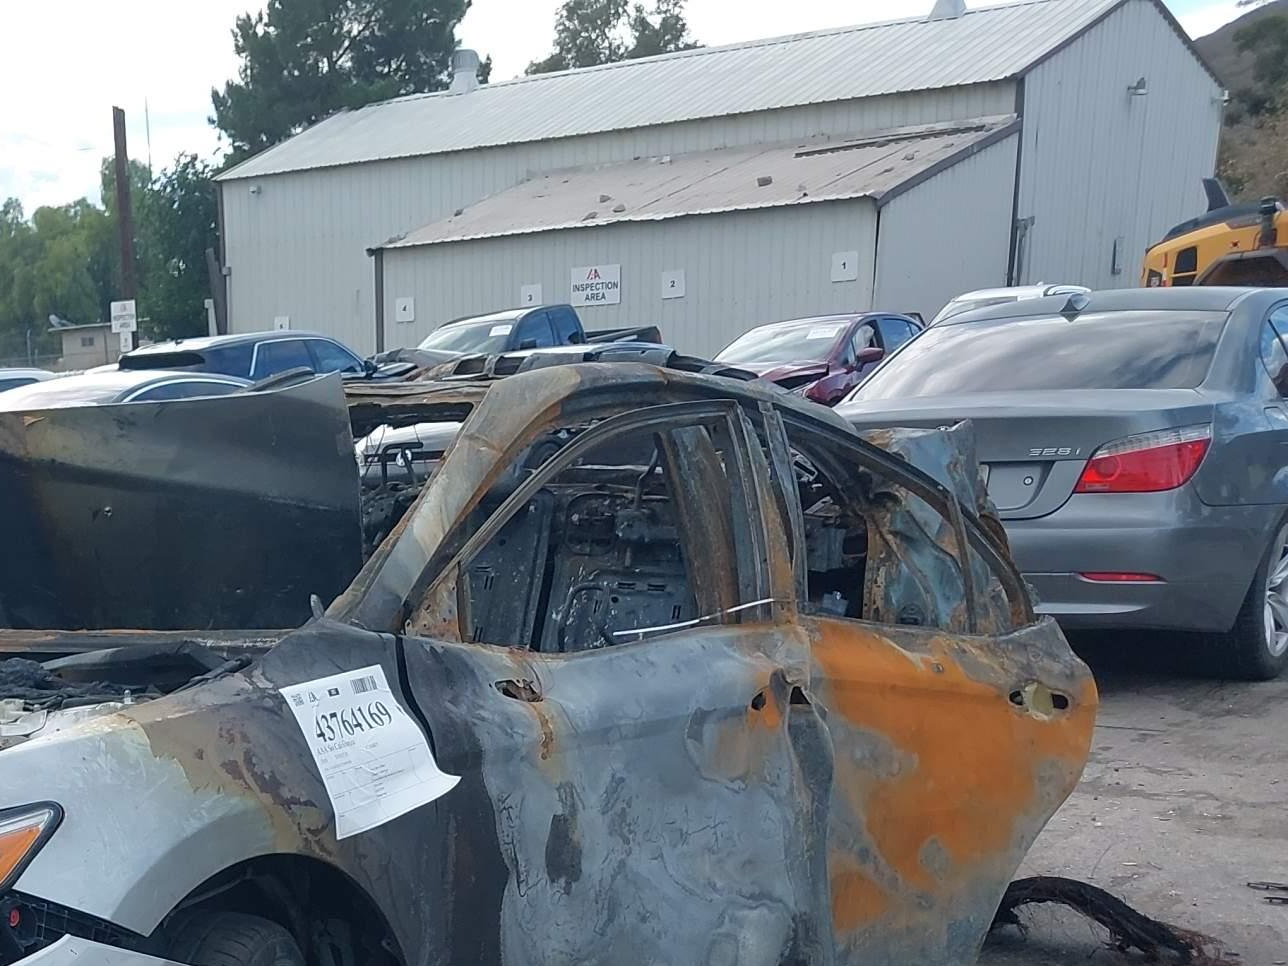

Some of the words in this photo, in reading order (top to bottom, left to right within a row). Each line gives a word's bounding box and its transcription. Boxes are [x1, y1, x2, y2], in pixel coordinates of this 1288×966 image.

[572, 281, 619, 292] INSPECTION
[669, 279, 676, 288] 2
[584, 292, 607, 301] AREA
[315, 701, 393, 743] 43764169
